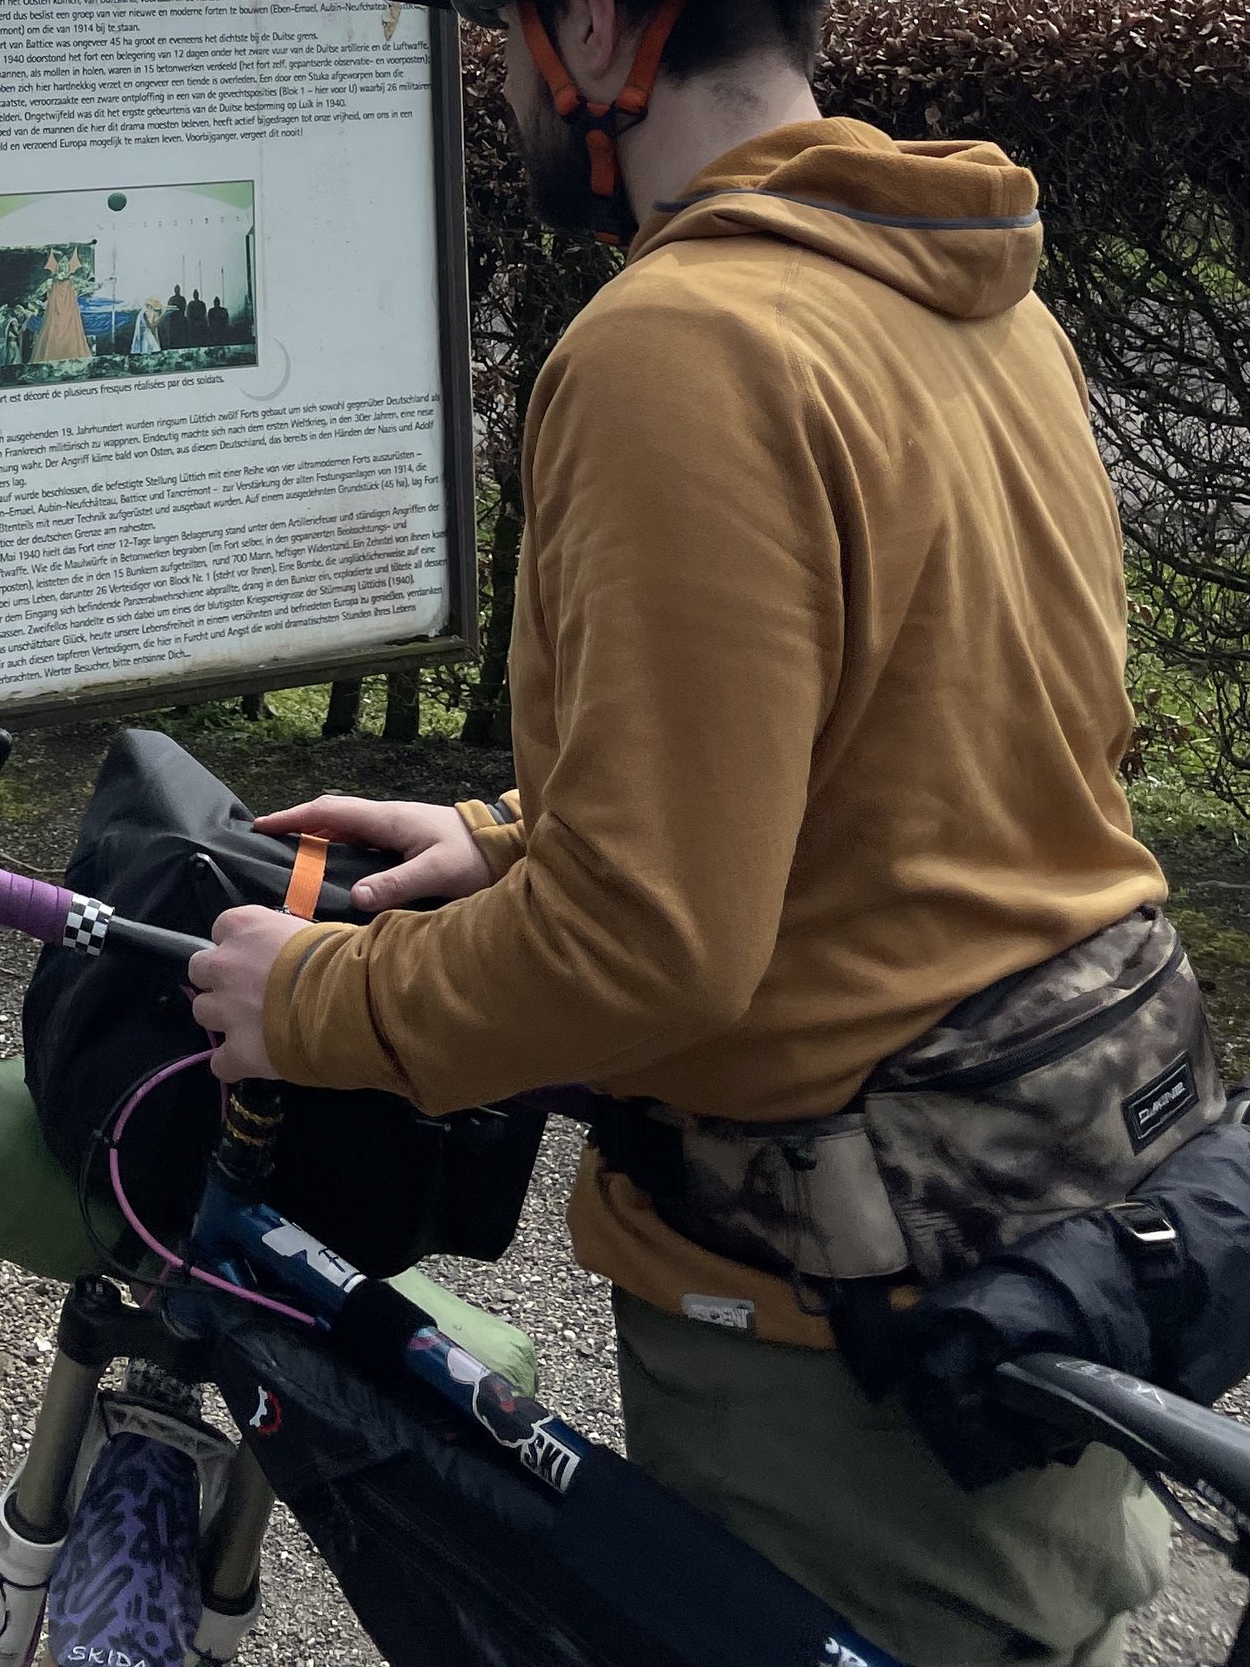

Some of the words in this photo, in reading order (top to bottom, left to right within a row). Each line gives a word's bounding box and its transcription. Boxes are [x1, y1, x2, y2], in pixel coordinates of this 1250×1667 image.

[9, 392, 21, 403] est
[23, 389, 49, 401] décoré
[51, 388, 61, 399] de
[63, 387, 98, 399] plusieurs
[99, 383, 132, 394] fresques
[133, 378, 165, 390] réalisées
[167, 379, 180, 390] par
[181, 376, 194, 386] des
[196, 374, 224, 385] soldats.
